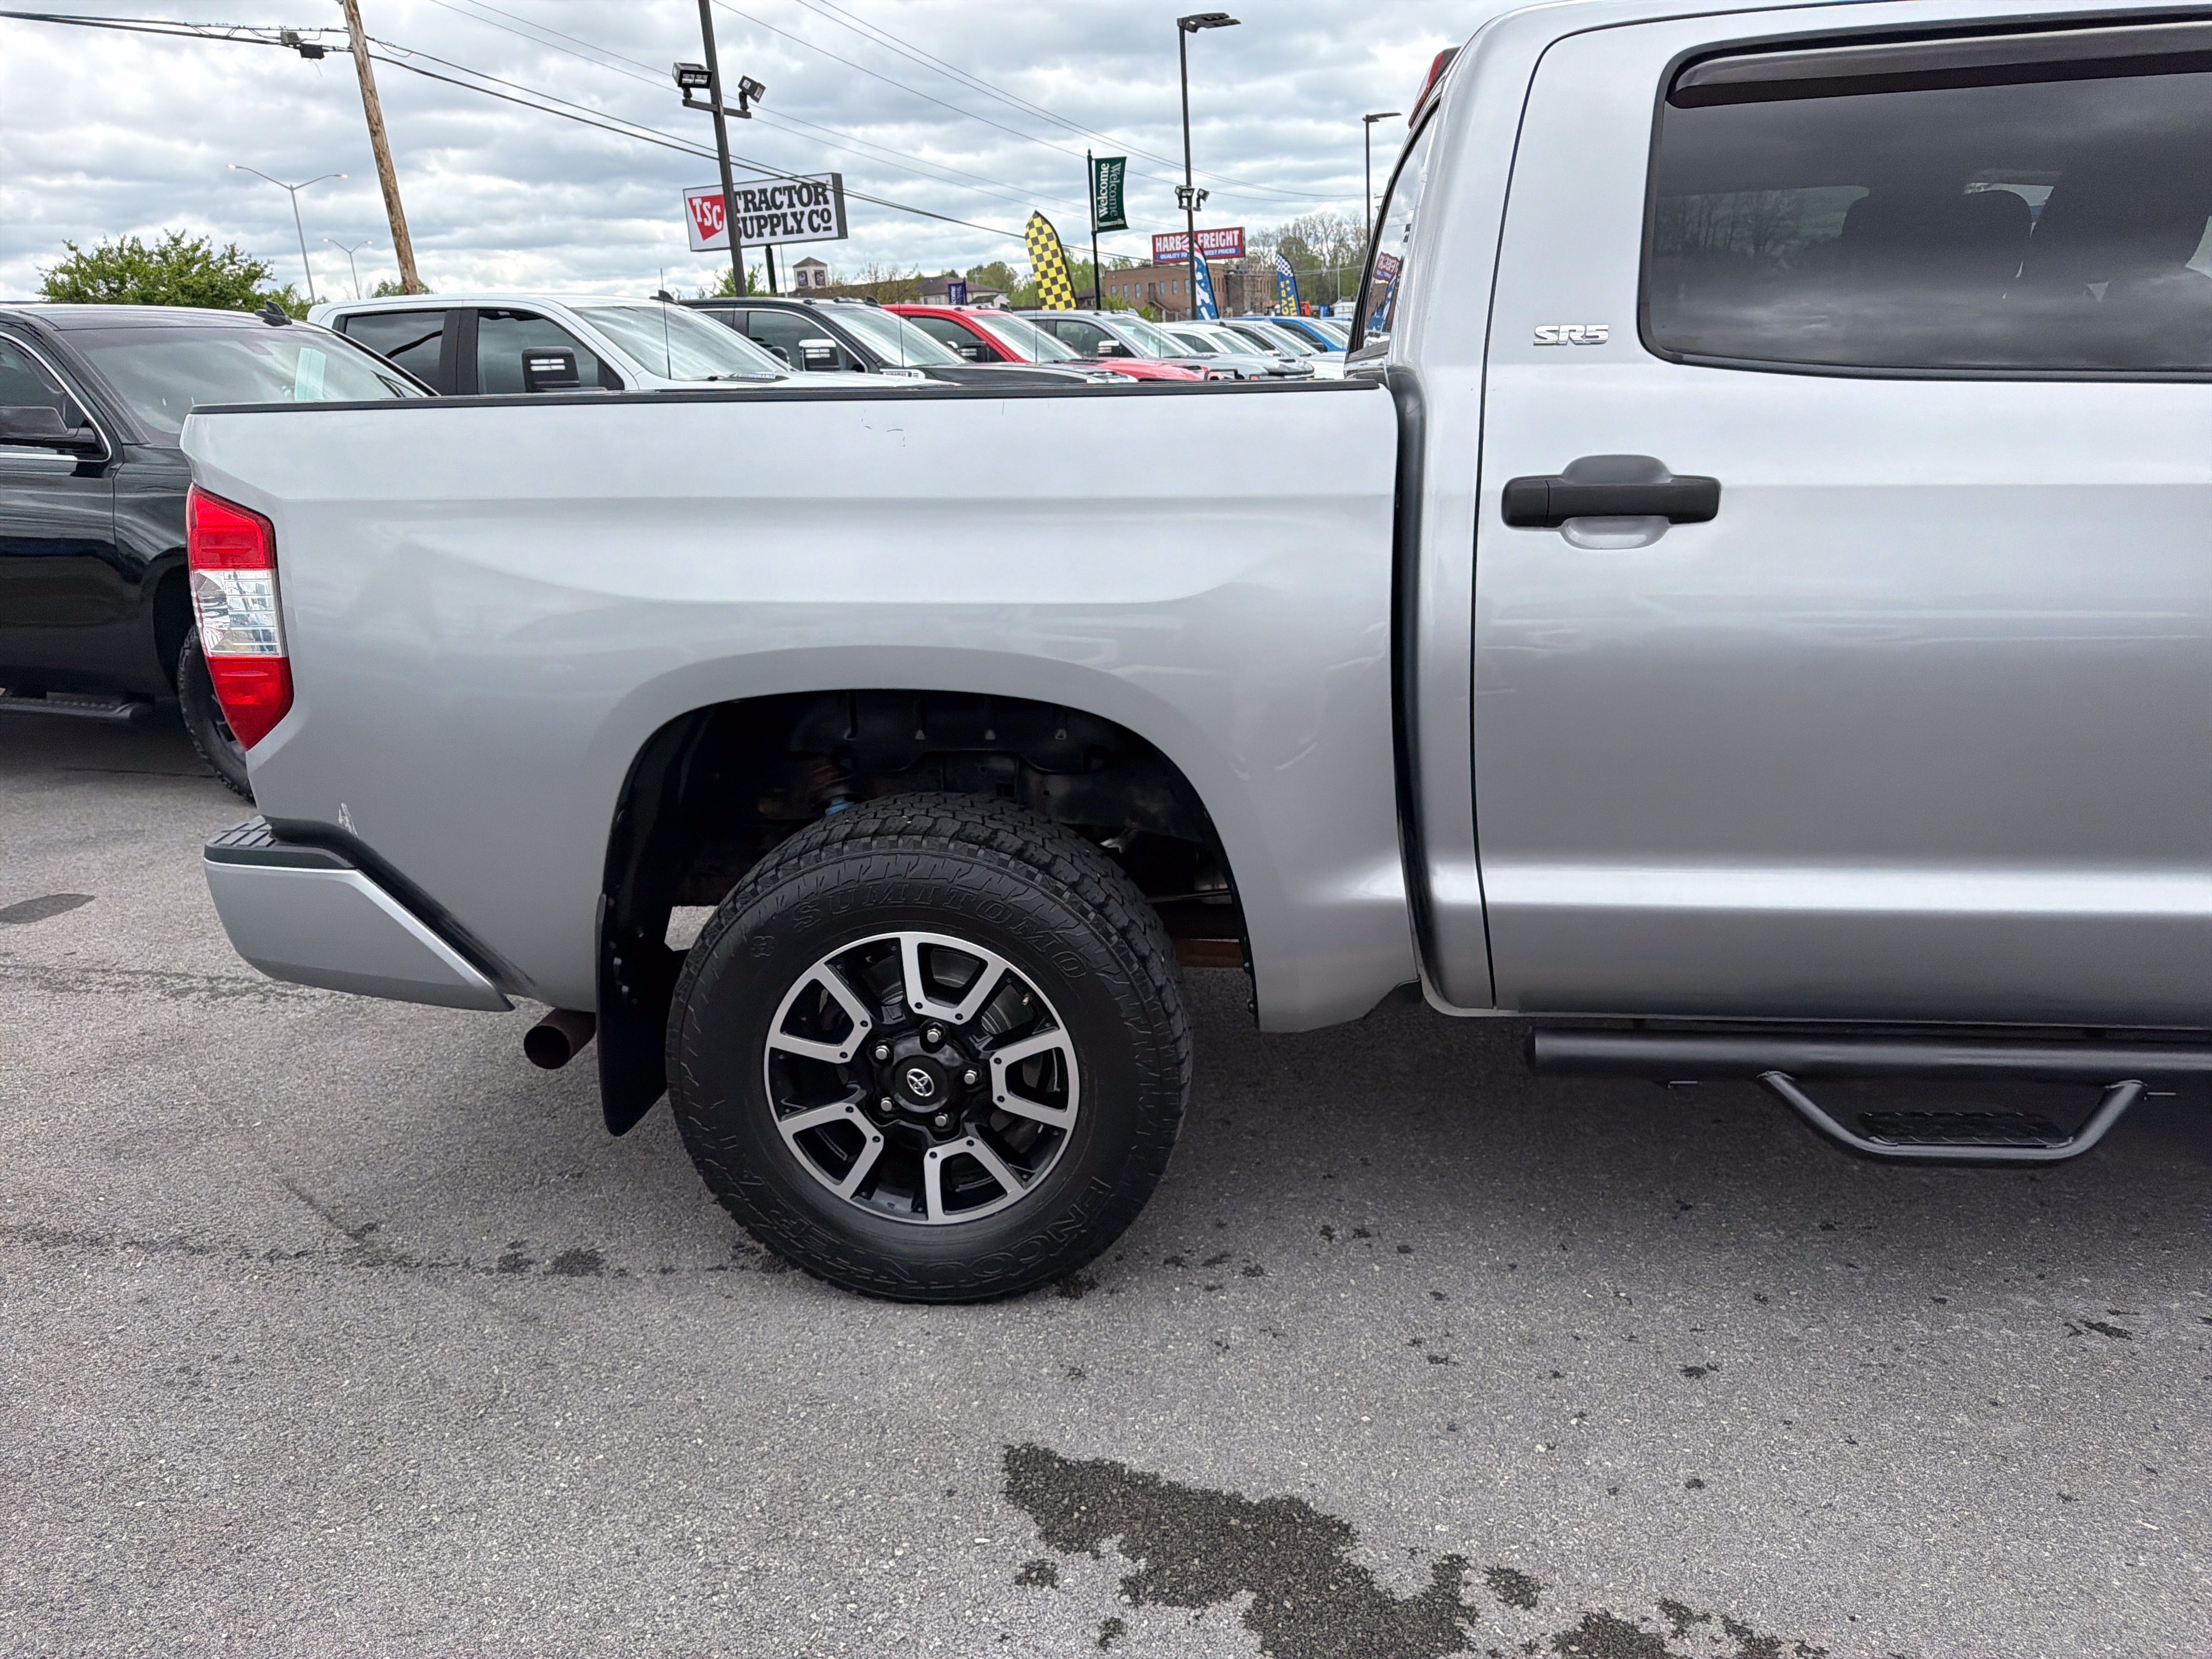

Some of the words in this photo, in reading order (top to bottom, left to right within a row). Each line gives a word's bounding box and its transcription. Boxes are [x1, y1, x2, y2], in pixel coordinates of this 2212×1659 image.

[1097, 163, 1109, 218] Welcome
[1109, 162, 1122, 217] Welcome
[692, 198, 723, 230] TSC
[737, 211, 804, 239] UPPLY
[1155, 235, 1187, 252] HARB
[1198, 230, 1239, 249] FREIGHT
[1533, 324, 1609, 345] SR5
[793, 882, 1089, 978] SUMITOMO
